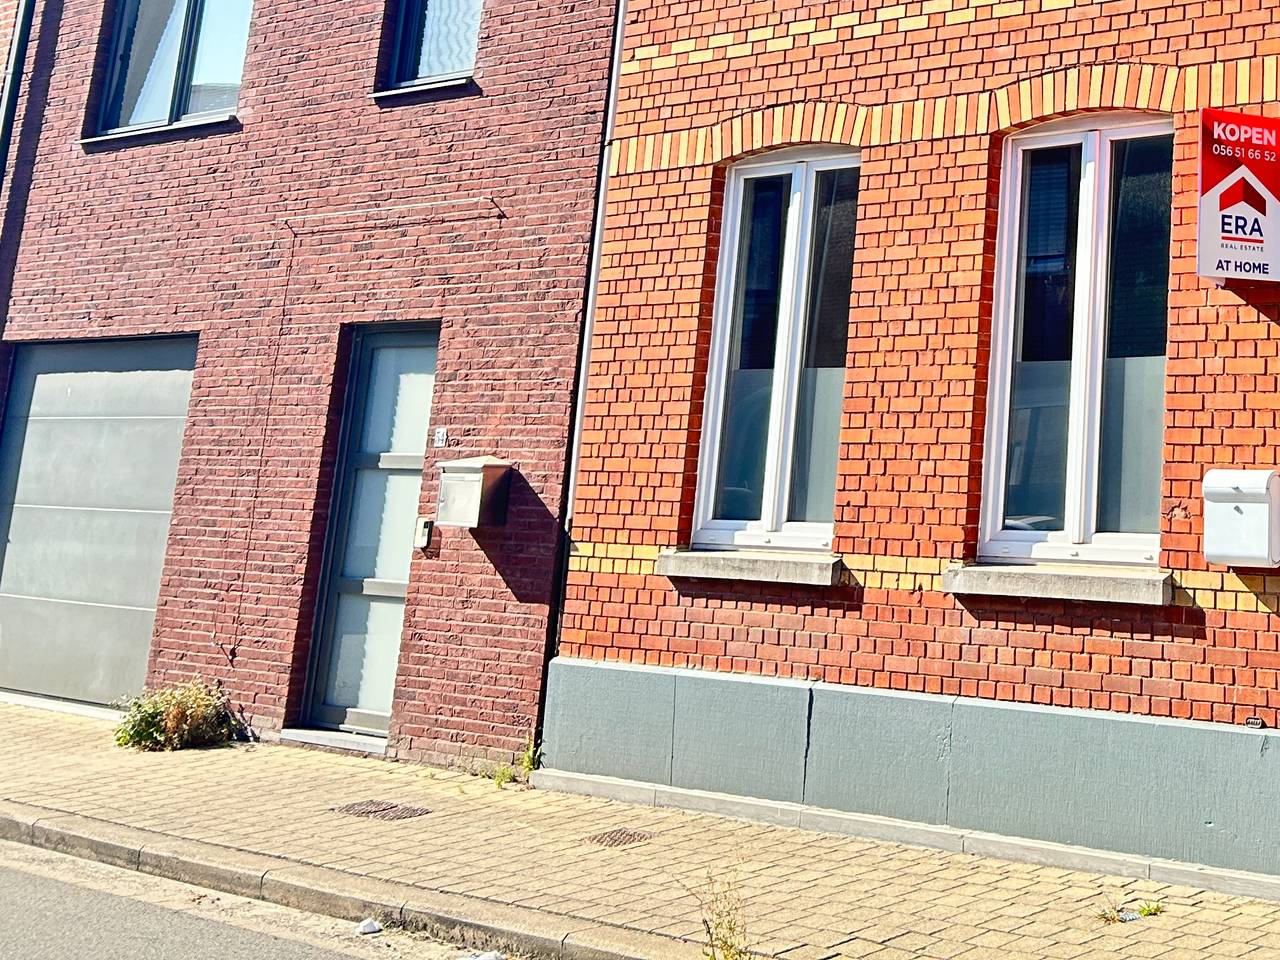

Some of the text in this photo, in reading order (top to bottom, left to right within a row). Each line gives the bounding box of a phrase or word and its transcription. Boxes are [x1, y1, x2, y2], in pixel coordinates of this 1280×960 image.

[1213, 121, 1277, 146] KOPEN
[1212, 143, 1277, 162] 056 51 66 52
[1221, 214, 1264, 237] ERA
[1220, 242, 1264, 253] REAL ESTATE
[1215, 259, 1269, 275] AT HOME
